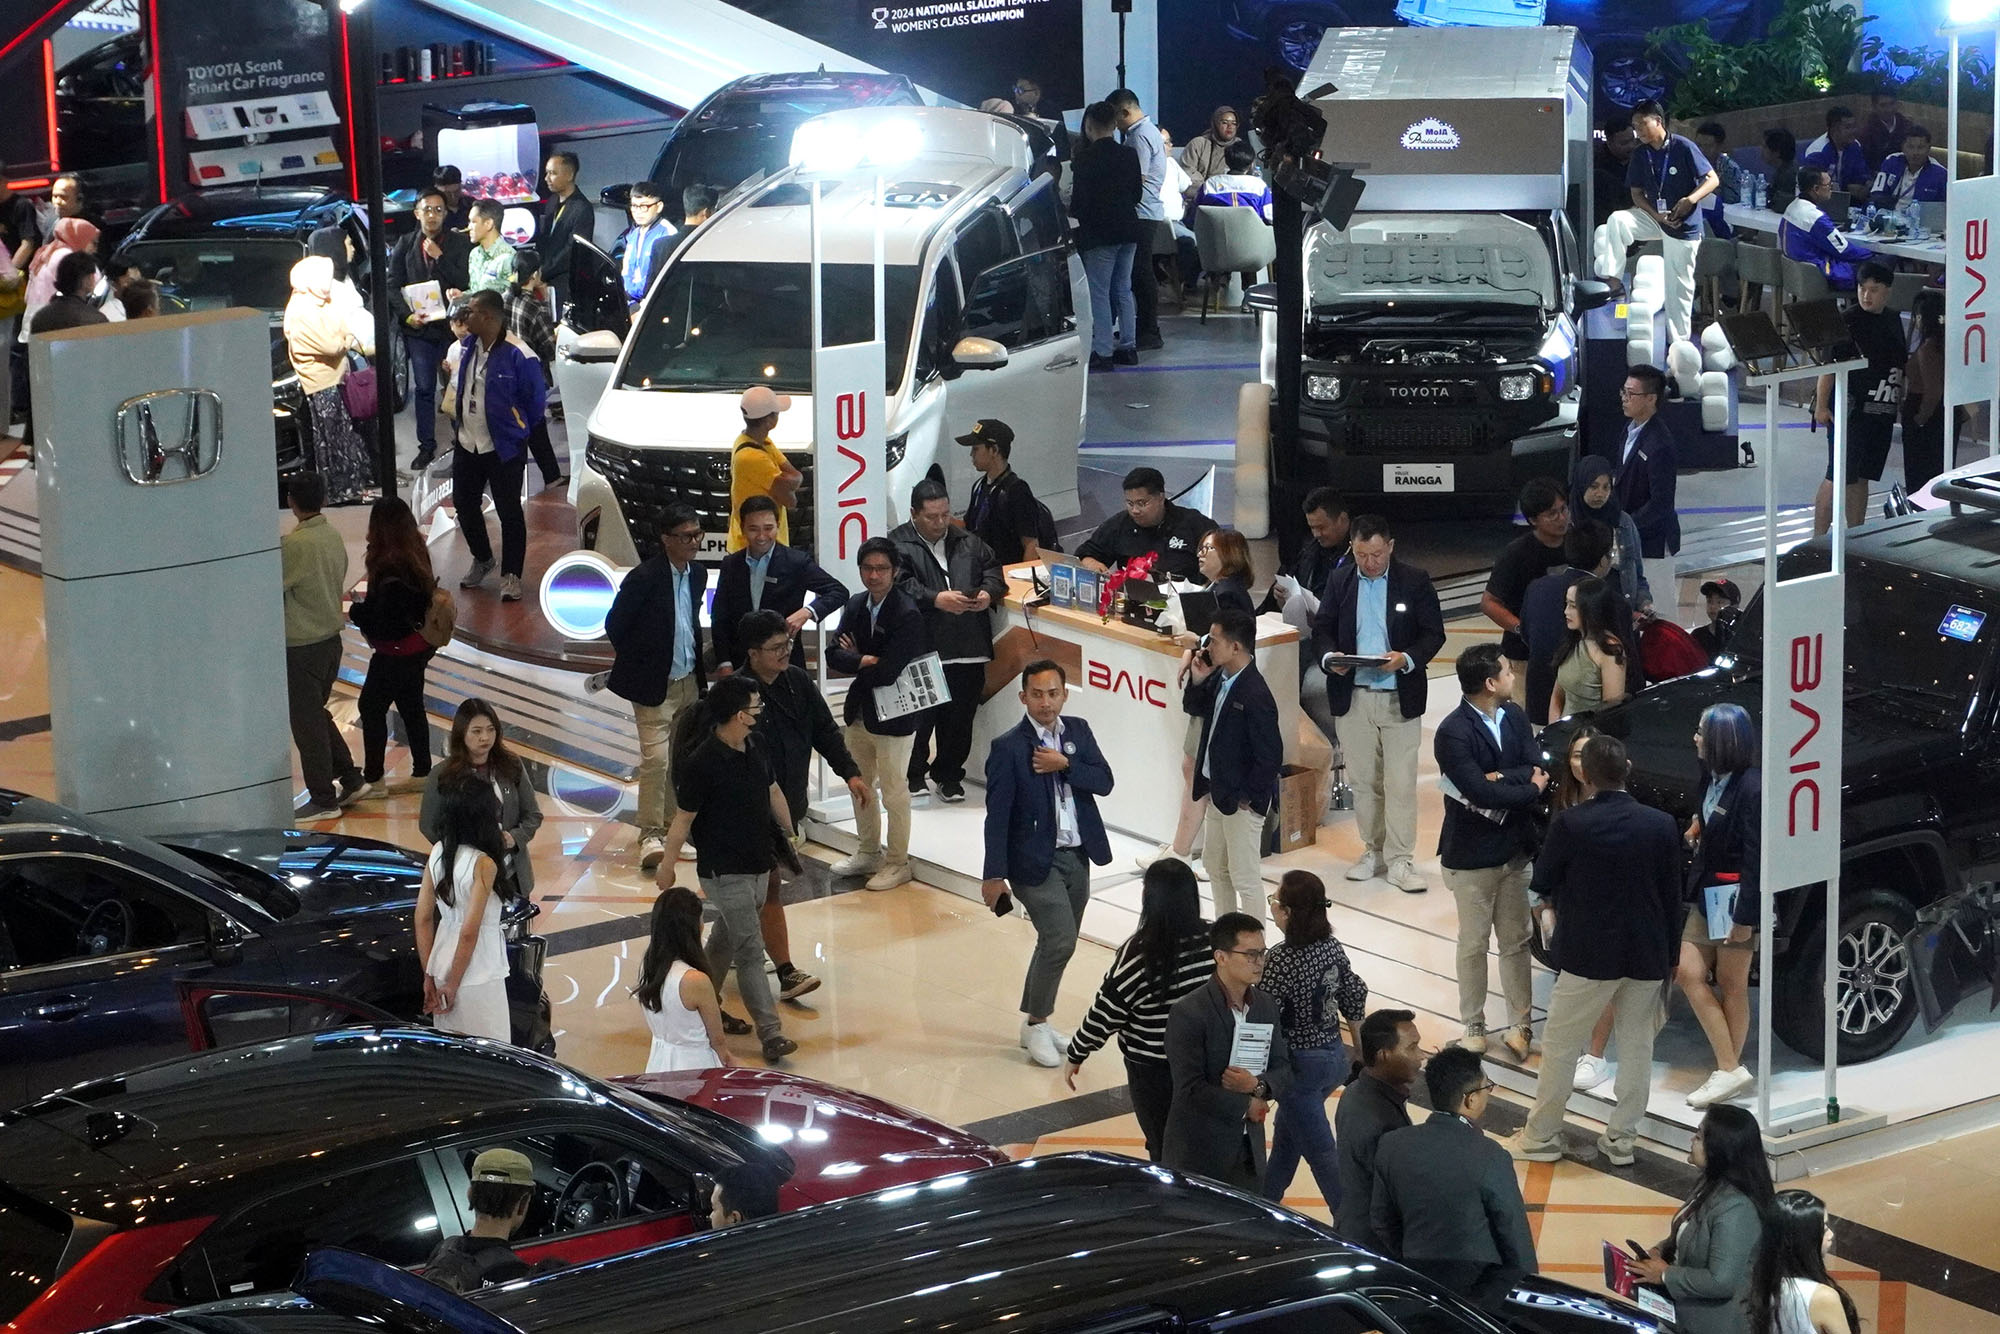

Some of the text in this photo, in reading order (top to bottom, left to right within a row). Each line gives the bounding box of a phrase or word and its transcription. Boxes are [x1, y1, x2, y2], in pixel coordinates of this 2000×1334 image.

[891, 8, 914, 19] 2024
[916, 2, 966, 17] NATIONAL
[966, 0, 1006, 11] SLALOM
[892, 8, 1024, 33] WOMEN'S CLASS CHAMPION
[187, 59, 283, 80] TOYOTA Scent
[188, 71, 326, 95] Smart Car Fragrance
[1964, 218, 1988, 366] BAIC
[1389, 387, 1449, 397] TOYOTA
[835, 390, 868, 561] BAIC
[1395, 476, 1442, 485] RANGGA
[1088, 660, 1167, 709] BAIC
[1789, 633, 1823, 837] BAIC
